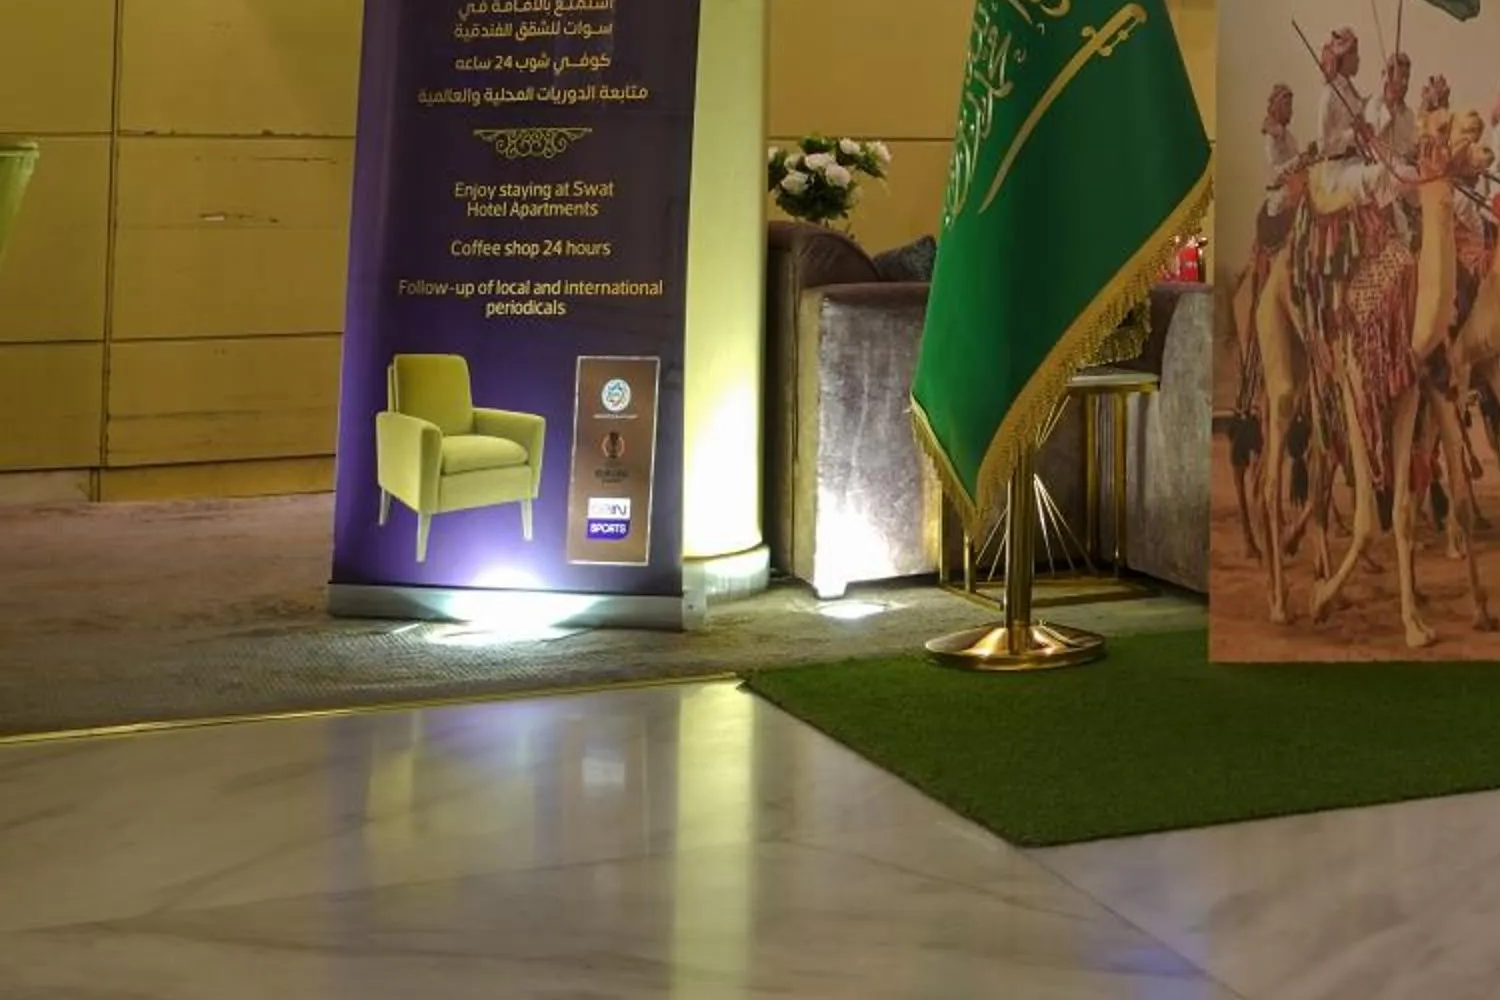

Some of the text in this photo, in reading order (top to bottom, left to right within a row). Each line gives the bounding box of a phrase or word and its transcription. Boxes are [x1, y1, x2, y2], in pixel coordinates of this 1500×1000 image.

[458, 0, 488, 20] في
[454, 19, 613, 41] سوات للشقق الفندقية
[495, 56, 513, 69] 24
[515, 51, 550, 72] شوب
[553, 51, 611, 75] كوفي
[418, 85, 649, 107] متابعة الدوريات المحلية والعالمية
[455, 181, 614, 200] Enjoy staying at Swat
[467, 201, 598, 220] Hotel Apartments
[451, 240, 611, 258] Coffee shop 24 hours
[399, 280, 475, 297] Follow-up
[478, 279, 496, 295] of
[497, 279, 530, 295] local
[533, 279, 561, 295] and
[486, 299, 566, 318] periodicals
